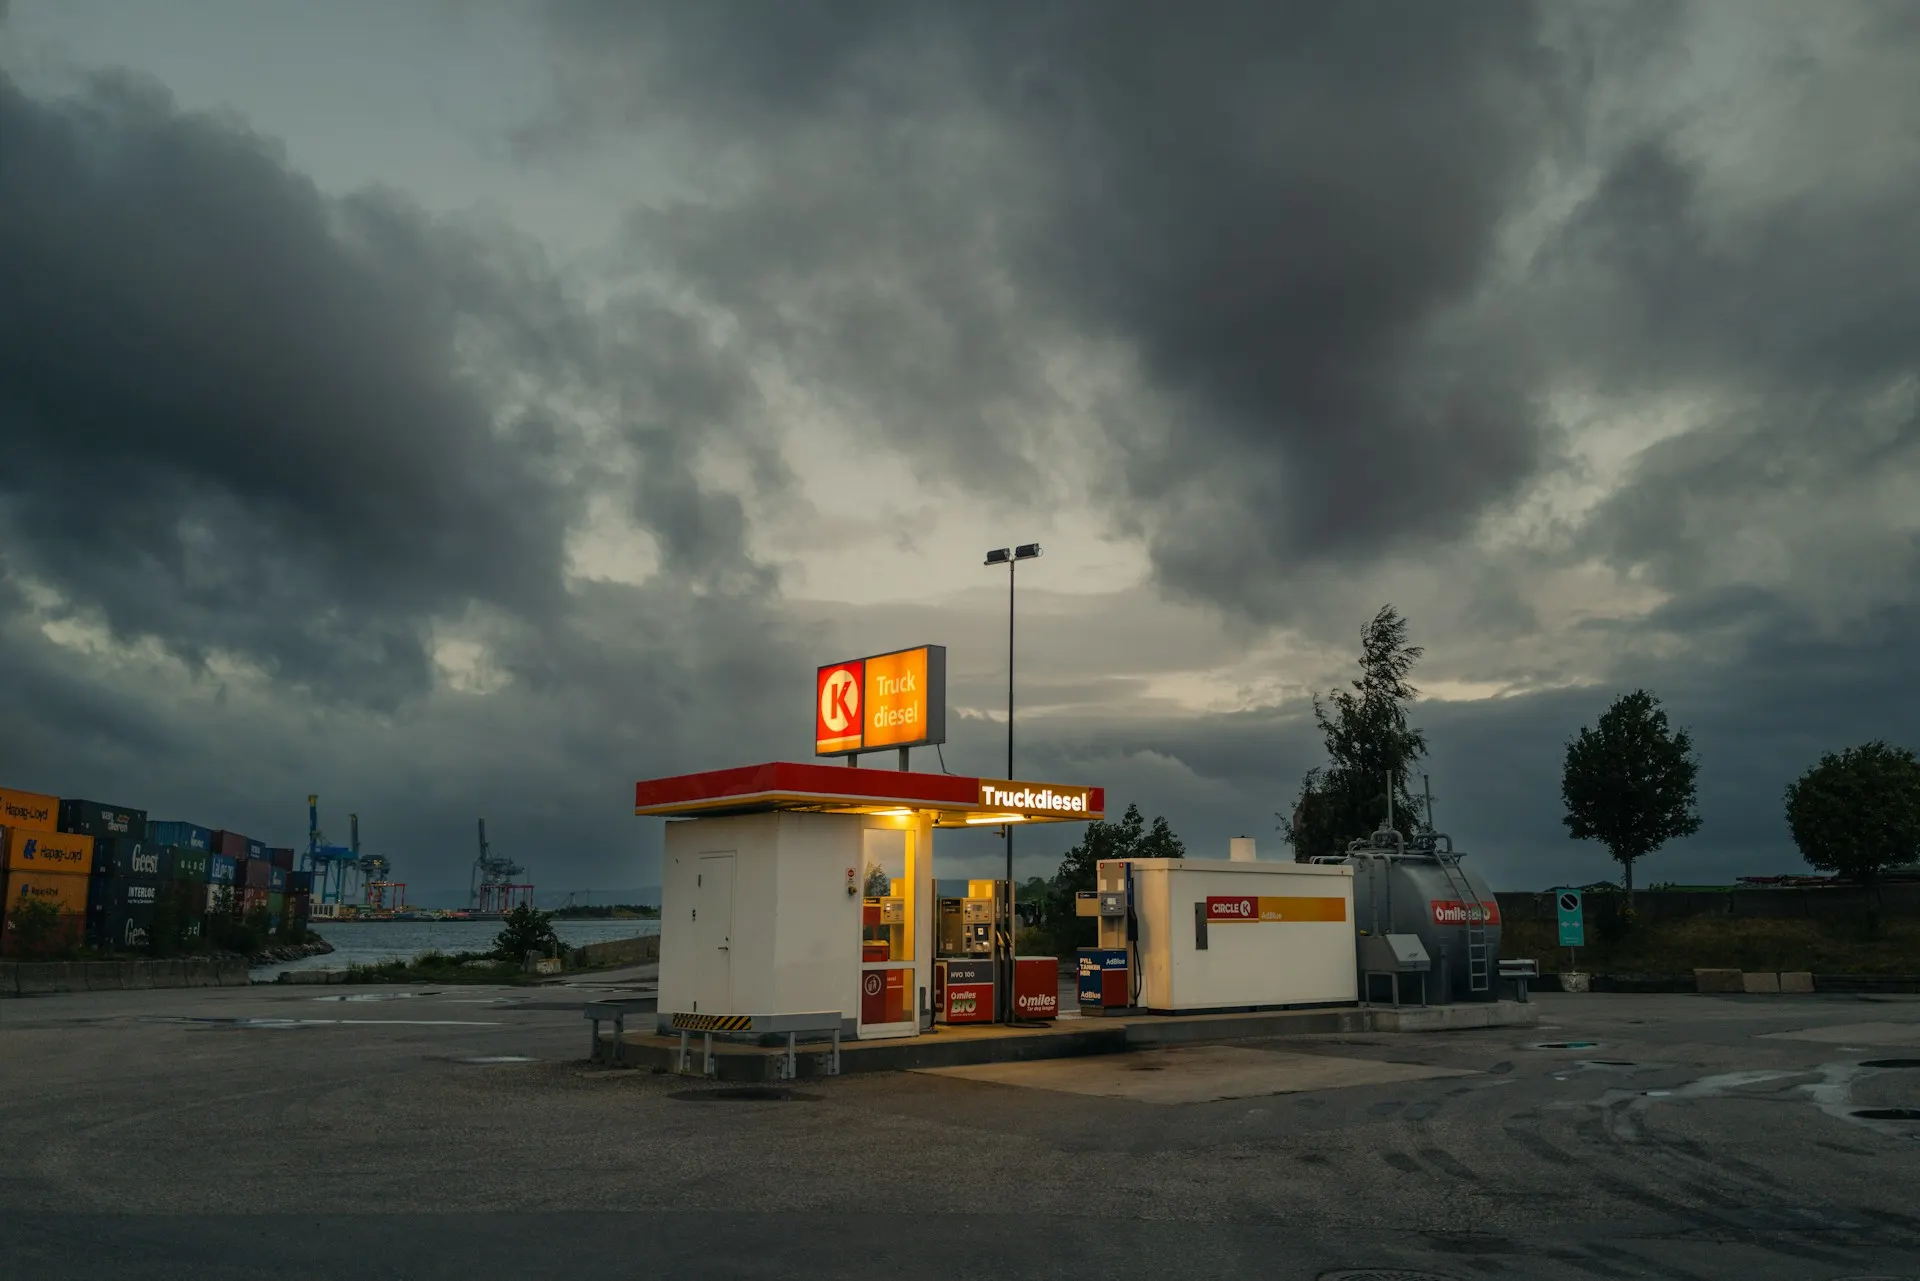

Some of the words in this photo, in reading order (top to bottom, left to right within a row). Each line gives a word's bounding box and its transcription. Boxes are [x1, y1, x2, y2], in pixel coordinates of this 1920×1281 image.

[876, 670, 916, 697] Truck
[873, 700, 918, 728] diesel
[982, 786, 1087, 812] Truckdiesel
[132, 843, 159, 873] Geest
[1212, 903, 1239, 914] CIRCLE
[1261, 911, 1282, 920] AdBlue
[1106, 958, 1126, 966] AdBlue
[956, 991, 976, 1000] miles
[1027, 994, 1056, 1007] miles
[1080, 991, 1101, 1000] AdBlue
[951, 1000, 977, 1014] BIO
